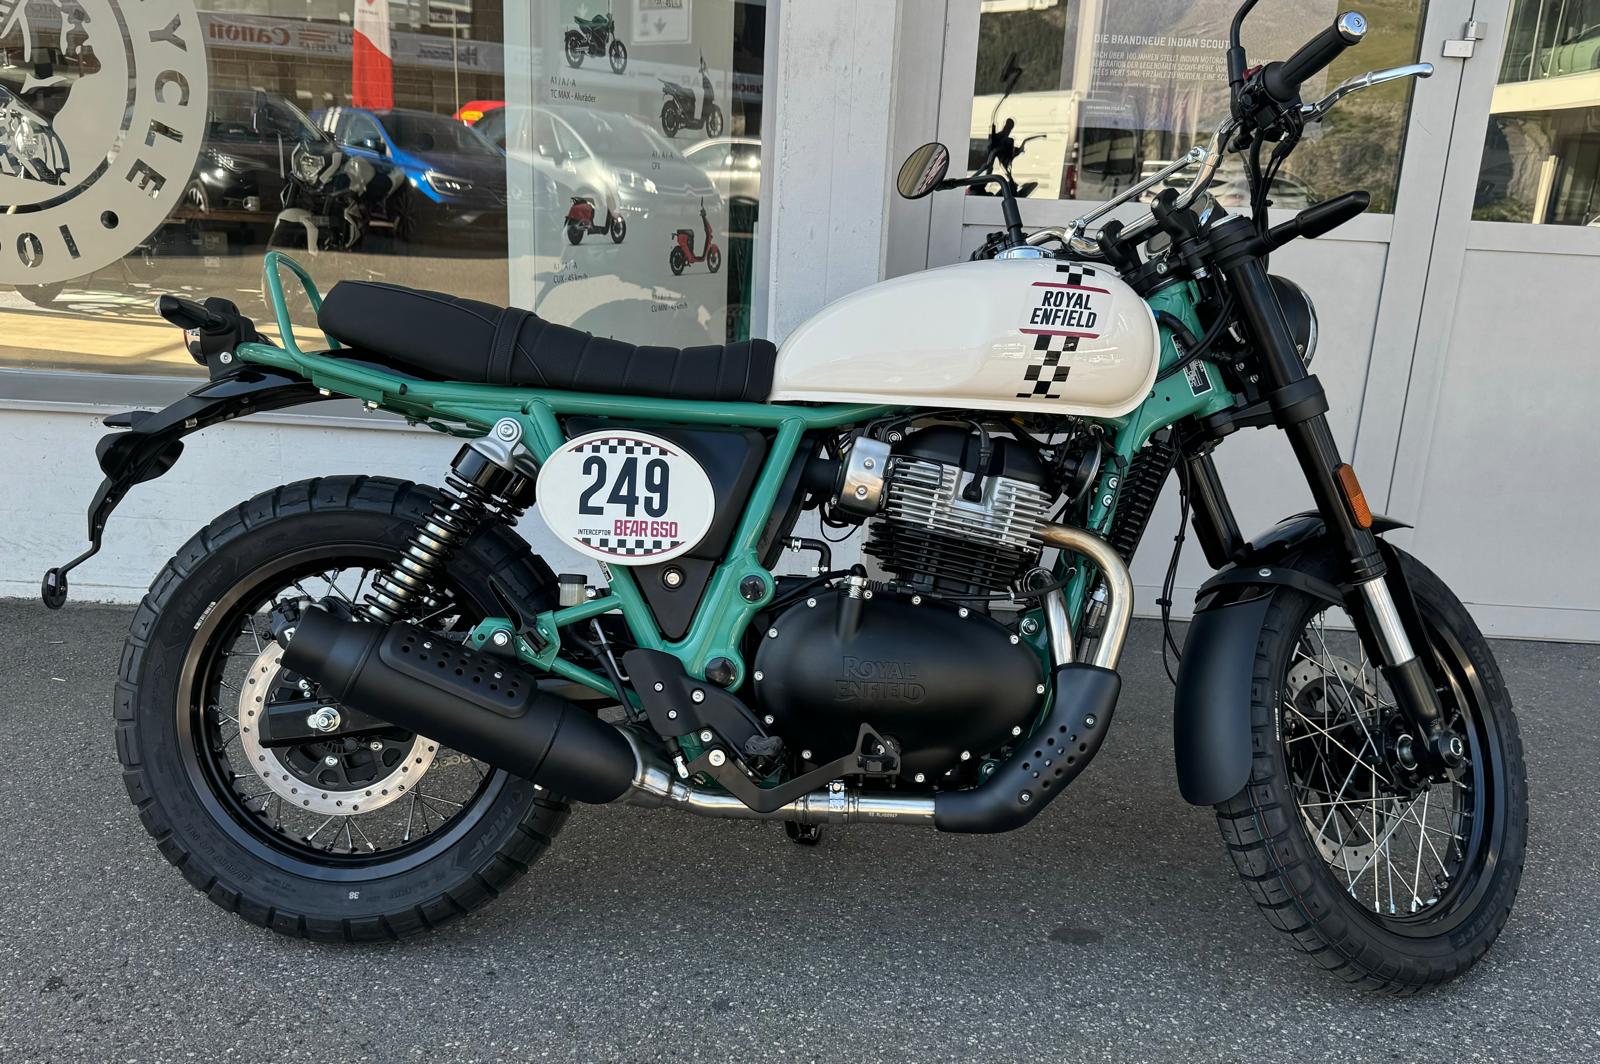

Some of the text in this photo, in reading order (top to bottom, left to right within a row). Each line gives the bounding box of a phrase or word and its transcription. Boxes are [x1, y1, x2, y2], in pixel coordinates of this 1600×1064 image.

[1094, 33, 1110, 44] DIE
[1111, 34, 1167, 47] BRANDNEUE
[1168, 36, 1199, 48] INDIAN
[125, 0, 190, 198] YCLE
[1041, 290, 1092, 310] ROYAL
[1029, 307, 1097, 329] ENFIELD
[578, 455, 670, 518] 249
[577, 519, 679, 539] INTERCEPTOR BEAR 650
[842, 655, 919, 681] ROYAL
[834, 679, 926, 704] ENFIELD
